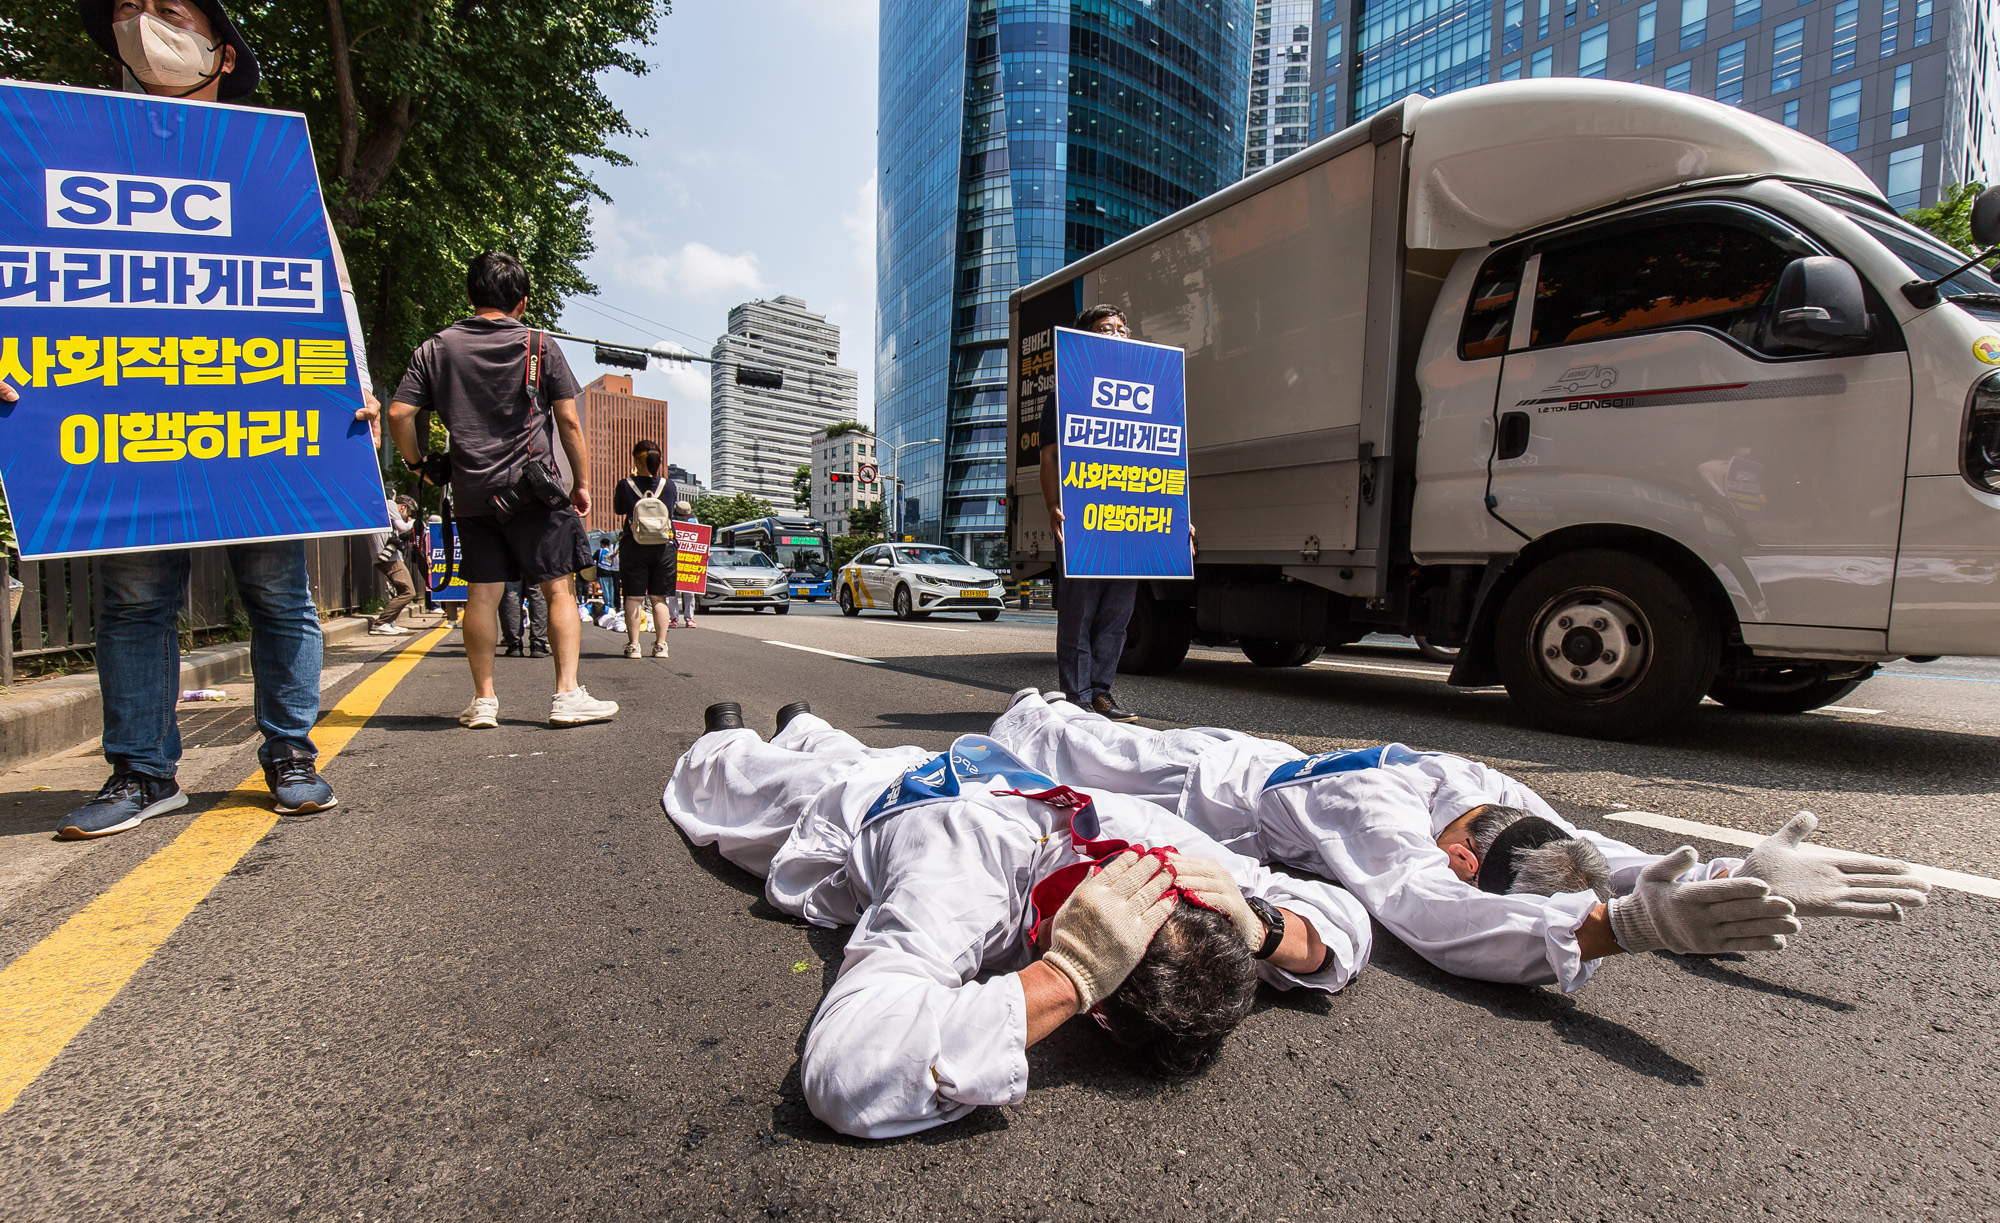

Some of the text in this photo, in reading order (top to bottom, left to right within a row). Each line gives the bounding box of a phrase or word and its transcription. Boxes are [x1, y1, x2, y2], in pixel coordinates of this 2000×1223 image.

[56, 176, 223, 231] SPC
[0, 251, 317, 308] 파리바게뜨
[1021, 328, 1050, 356] 윙바디
[0, 336, 349, 388] 사회적합의를
[529, 354, 539, 381] Canon
[1095, 380, 1151, 411] SPC
[1551, 405, 1567, 413] TON
[1568, 398, 1624, 411] BONGO
[59, 410, 320, 465] 이행하라!
[1068, 416, 1180, 454] 파리바게뜨
[1063, 461, 1186, 496] 사회적합의를
[1083, 503, 1173, 534] 이행하라!
[676, 531, 697, 541] SPC
